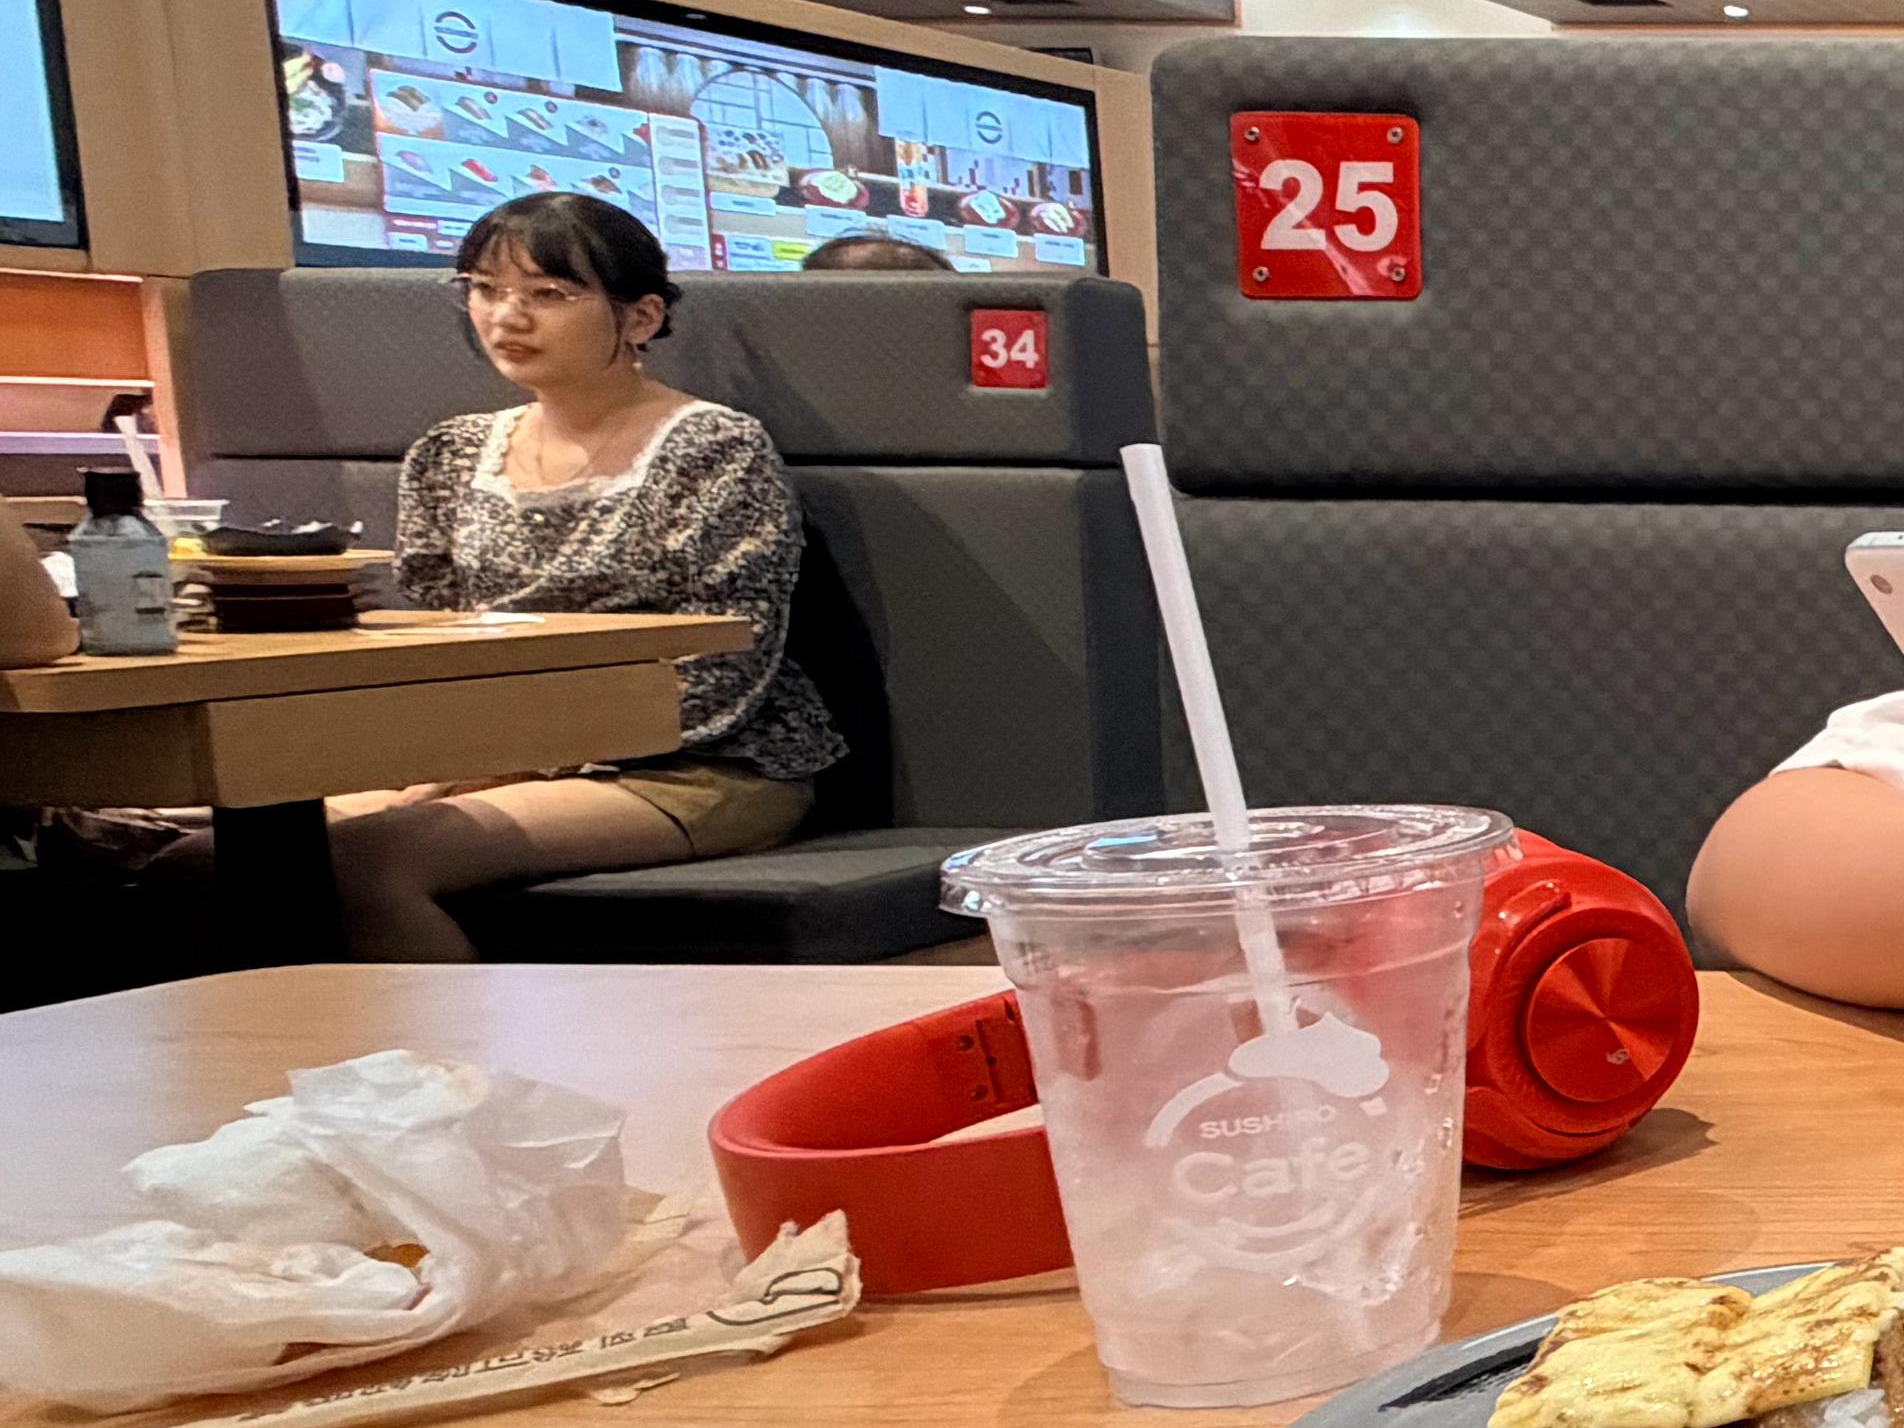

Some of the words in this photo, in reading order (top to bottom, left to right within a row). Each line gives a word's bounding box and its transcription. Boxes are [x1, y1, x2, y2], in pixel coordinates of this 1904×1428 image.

[1258, 158, 1400, 253] 25
[979, 327, 1040, 370] 34
[1200, 1104, 1337, 1139] SUSHO
[1173, 1136, 1371, 1203] Cafe
